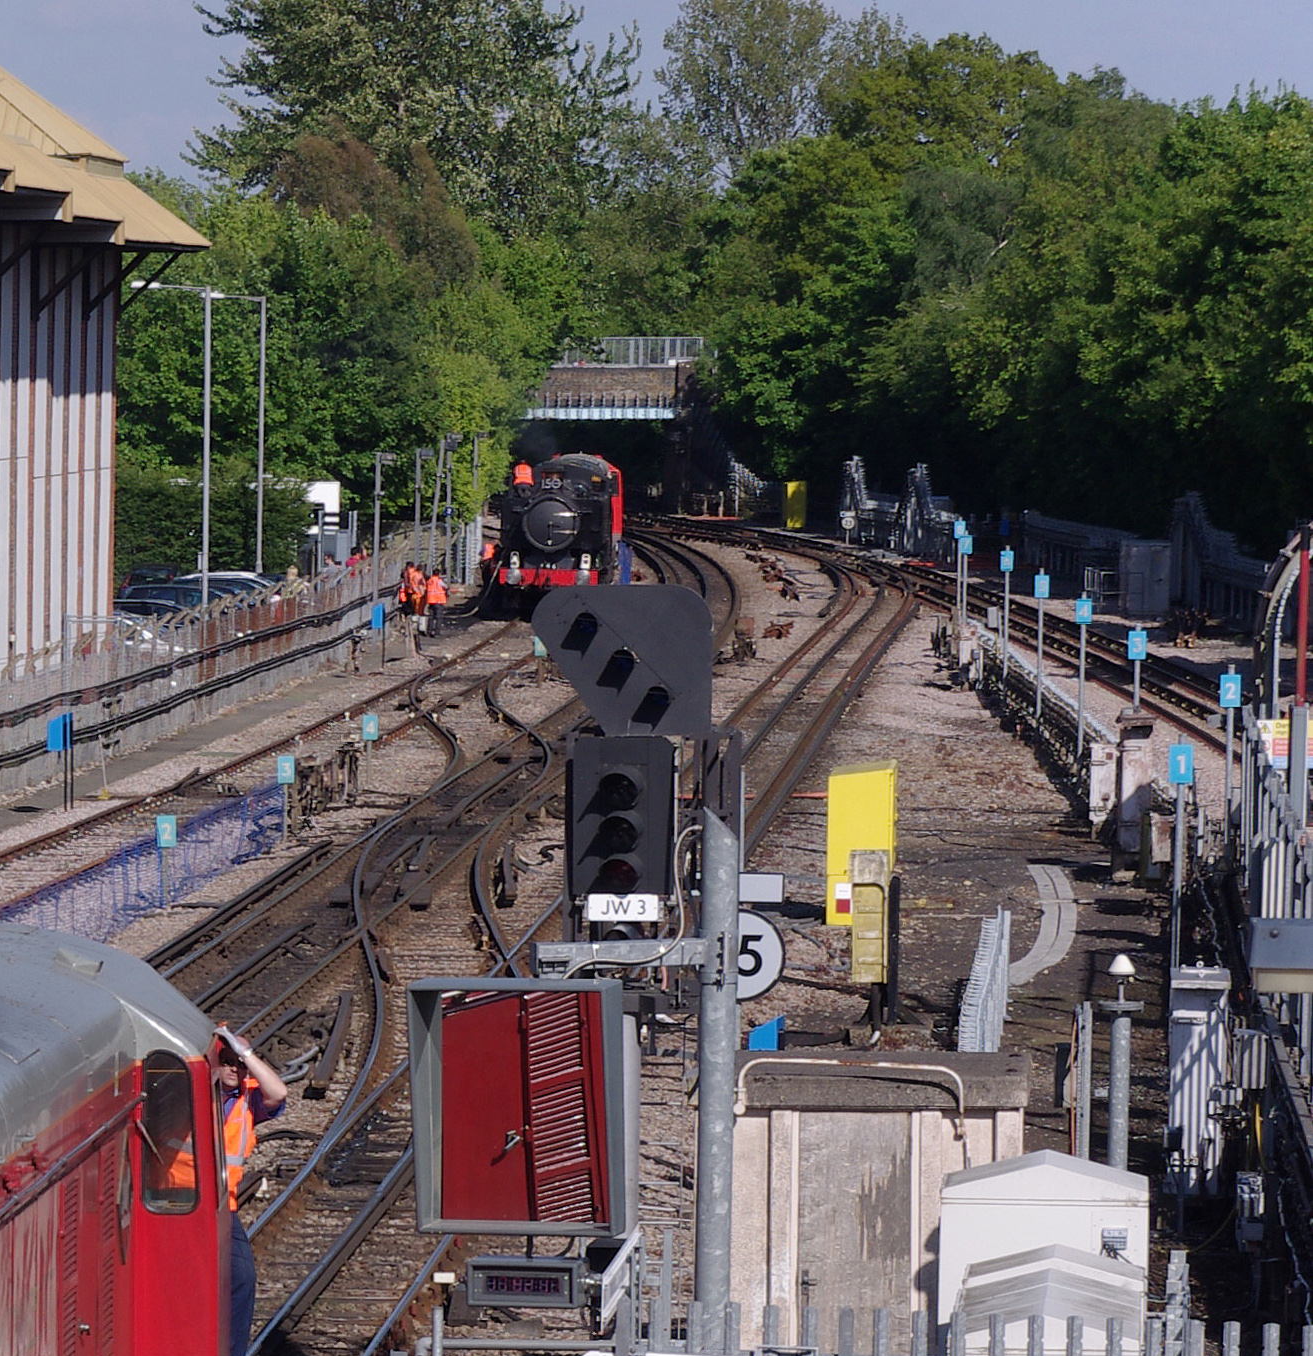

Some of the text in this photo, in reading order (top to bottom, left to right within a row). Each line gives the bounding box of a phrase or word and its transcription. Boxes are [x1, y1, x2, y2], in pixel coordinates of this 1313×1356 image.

[1079, 605, 1088, 618] 4
[1132, 638, 1143, 652] 3
[1225, 683, 1236, 699] 2
[366, 721, 375, 734] 4
[282, 763, 291, 777] 3
[1176, 754, 1185, 775] 1
[161, 823, 172, 840] 2
[601, 899, 646, 915] JW 3
